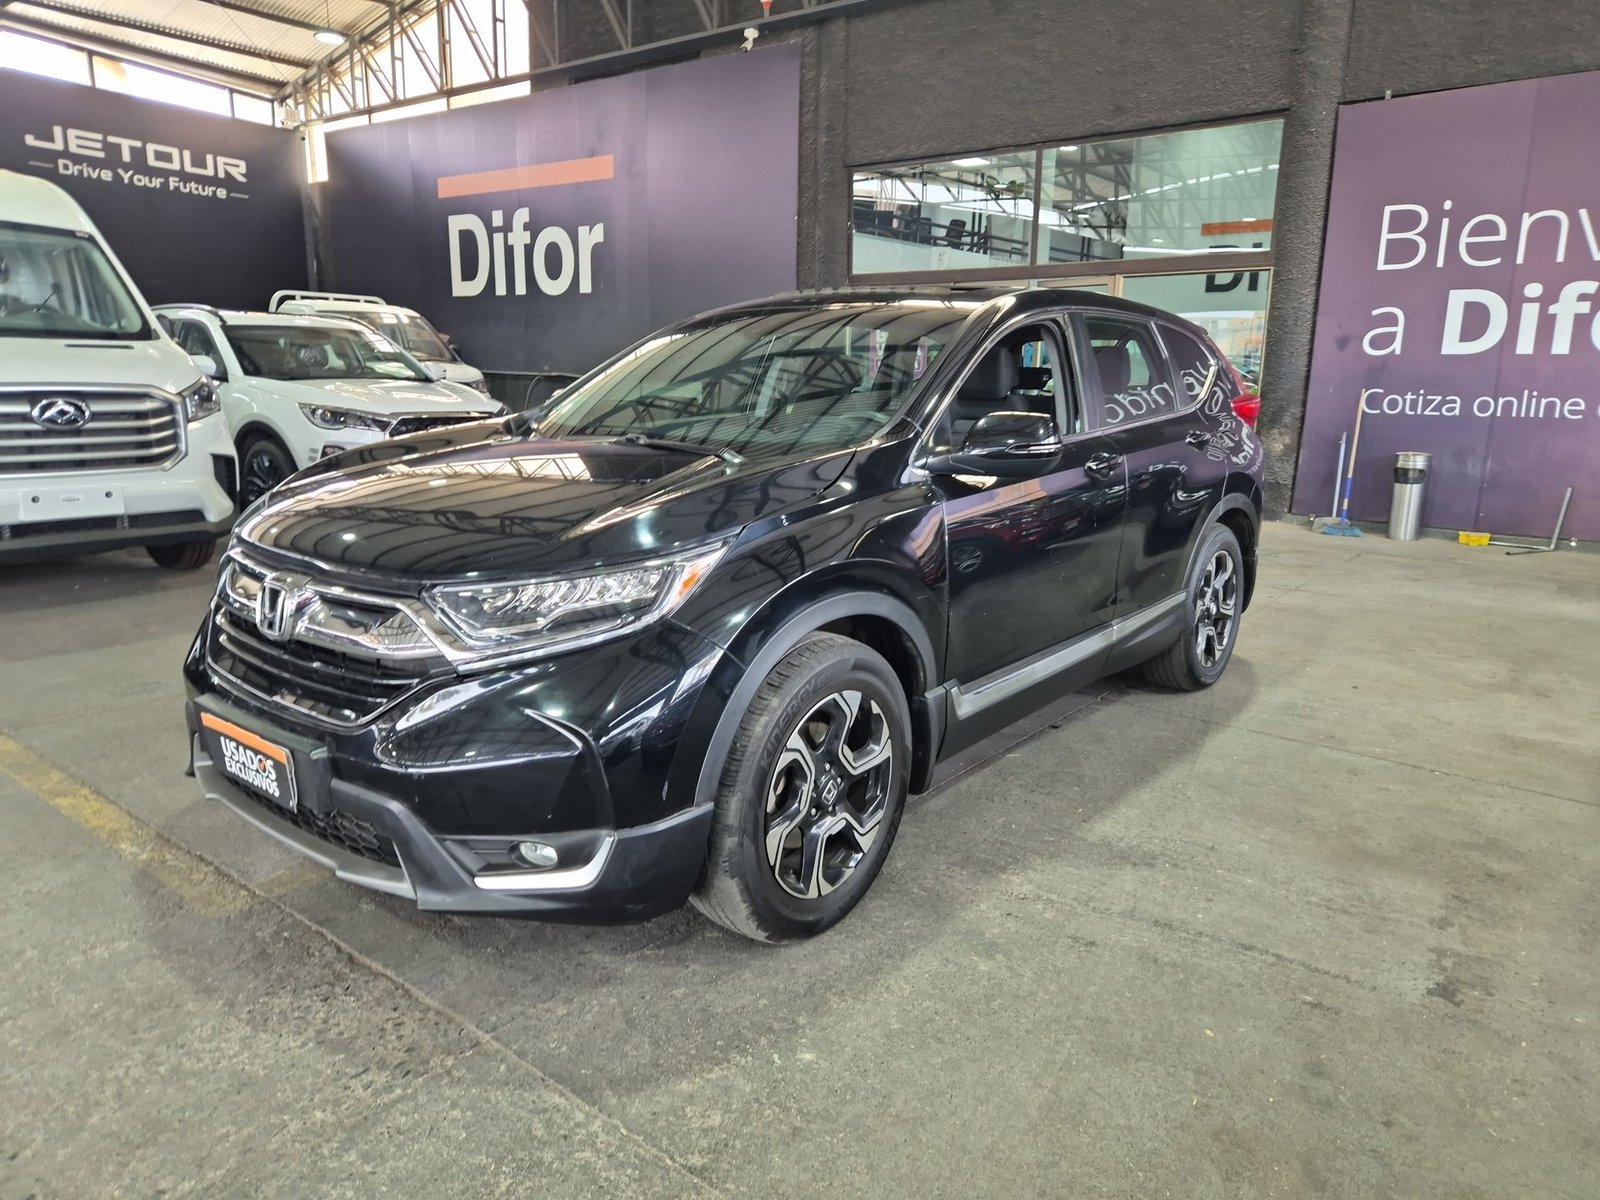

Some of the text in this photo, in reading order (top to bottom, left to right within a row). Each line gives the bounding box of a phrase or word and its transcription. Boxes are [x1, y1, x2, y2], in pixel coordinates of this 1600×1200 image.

[24, 125, 248, 183] JETOUR
[57, 158, 228, 199] Drive Your Future
[448, 207, 604, 297] Difor
[1362, 280, 1600, 356] a Dif
[1362, 388, 1461, 416] Cotiza
[1473, 389, 1586, 419] online
[220, 736, 277, 781] USADOS
[224, 757, 280, 798] EXCLUSIVOS
